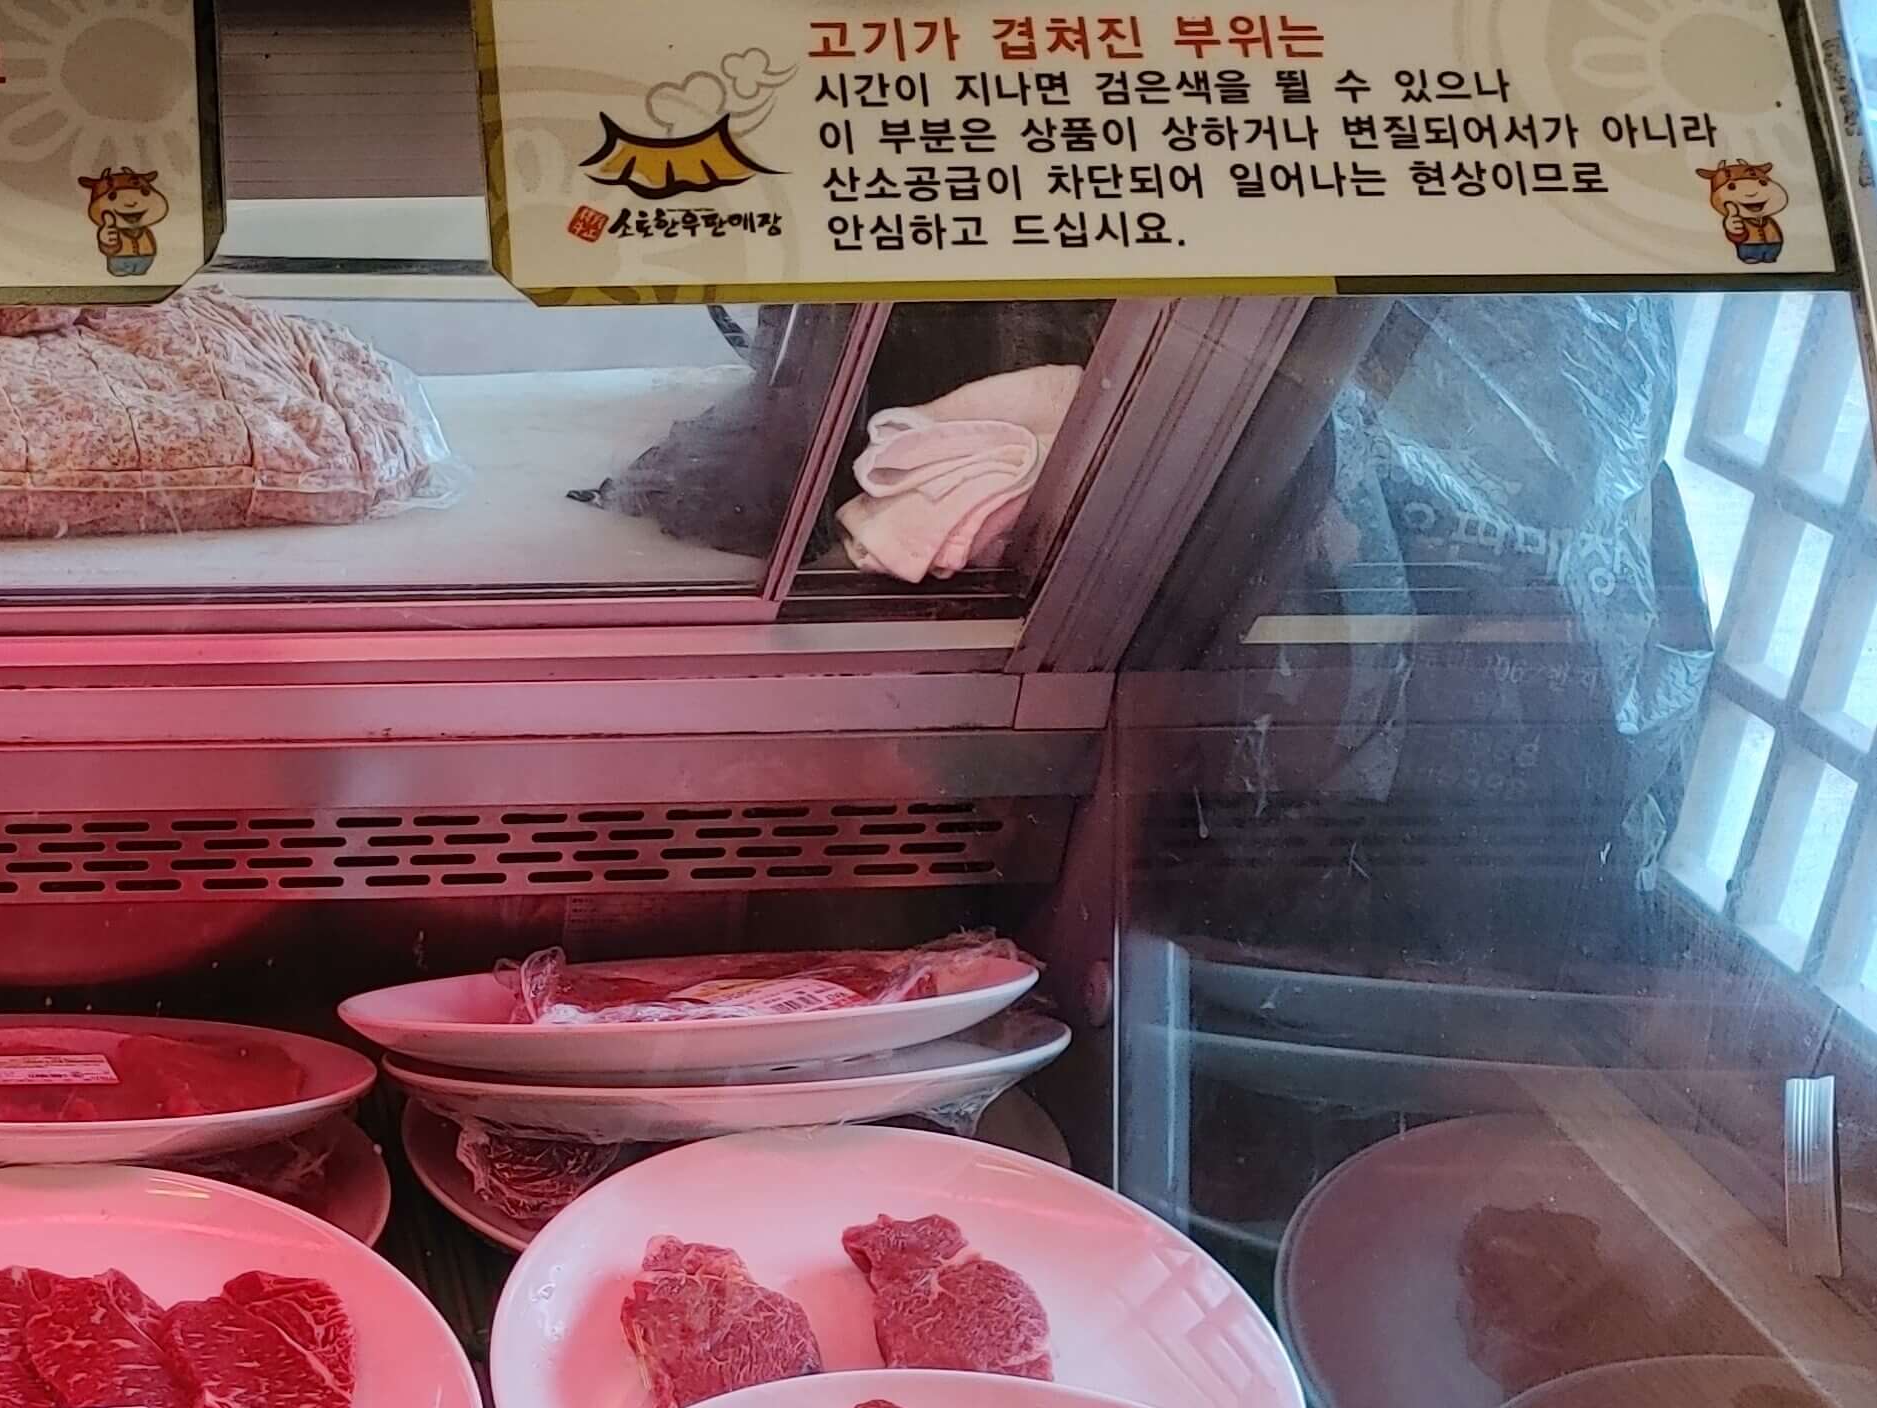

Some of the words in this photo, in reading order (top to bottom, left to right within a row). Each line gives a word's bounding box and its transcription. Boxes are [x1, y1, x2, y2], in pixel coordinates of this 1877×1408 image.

[808, 17, 960, 61] 고기가
[992, 16, 1144, 60] 겹쳐진
[1174, 15, 1324, 59] 부위는
[814, 72, 930, 108] 시간이
[955, 71, 1071, 106] 지나면
[1095, 69, 1251, 105] 검은색을
[1335, 69, 1372, 103] 수
[1394, 68, 1510, 103] 있으나
[819, 119, 854, 155] 이
[878, 117, 997, 154] 부분은
[1020, 116, 1137, 152] 상품이
[1161, 114, 1319, 151] 상하거나
[1342, 114, 1578, 149] 변질되어서가
[1602, 113, 1717, 148] 아니라
[823, 163, 1022, 202] 산소공급이
[1047, 163, 1204, 199] 차단되어
[1229, 161, 1386, 198] 일어나는
[1409, 160, 1609, 197] 현상이므로
[827, 213, 989, 250] 안심하고
[1012, 211, 1185, 248] 드십시요.
